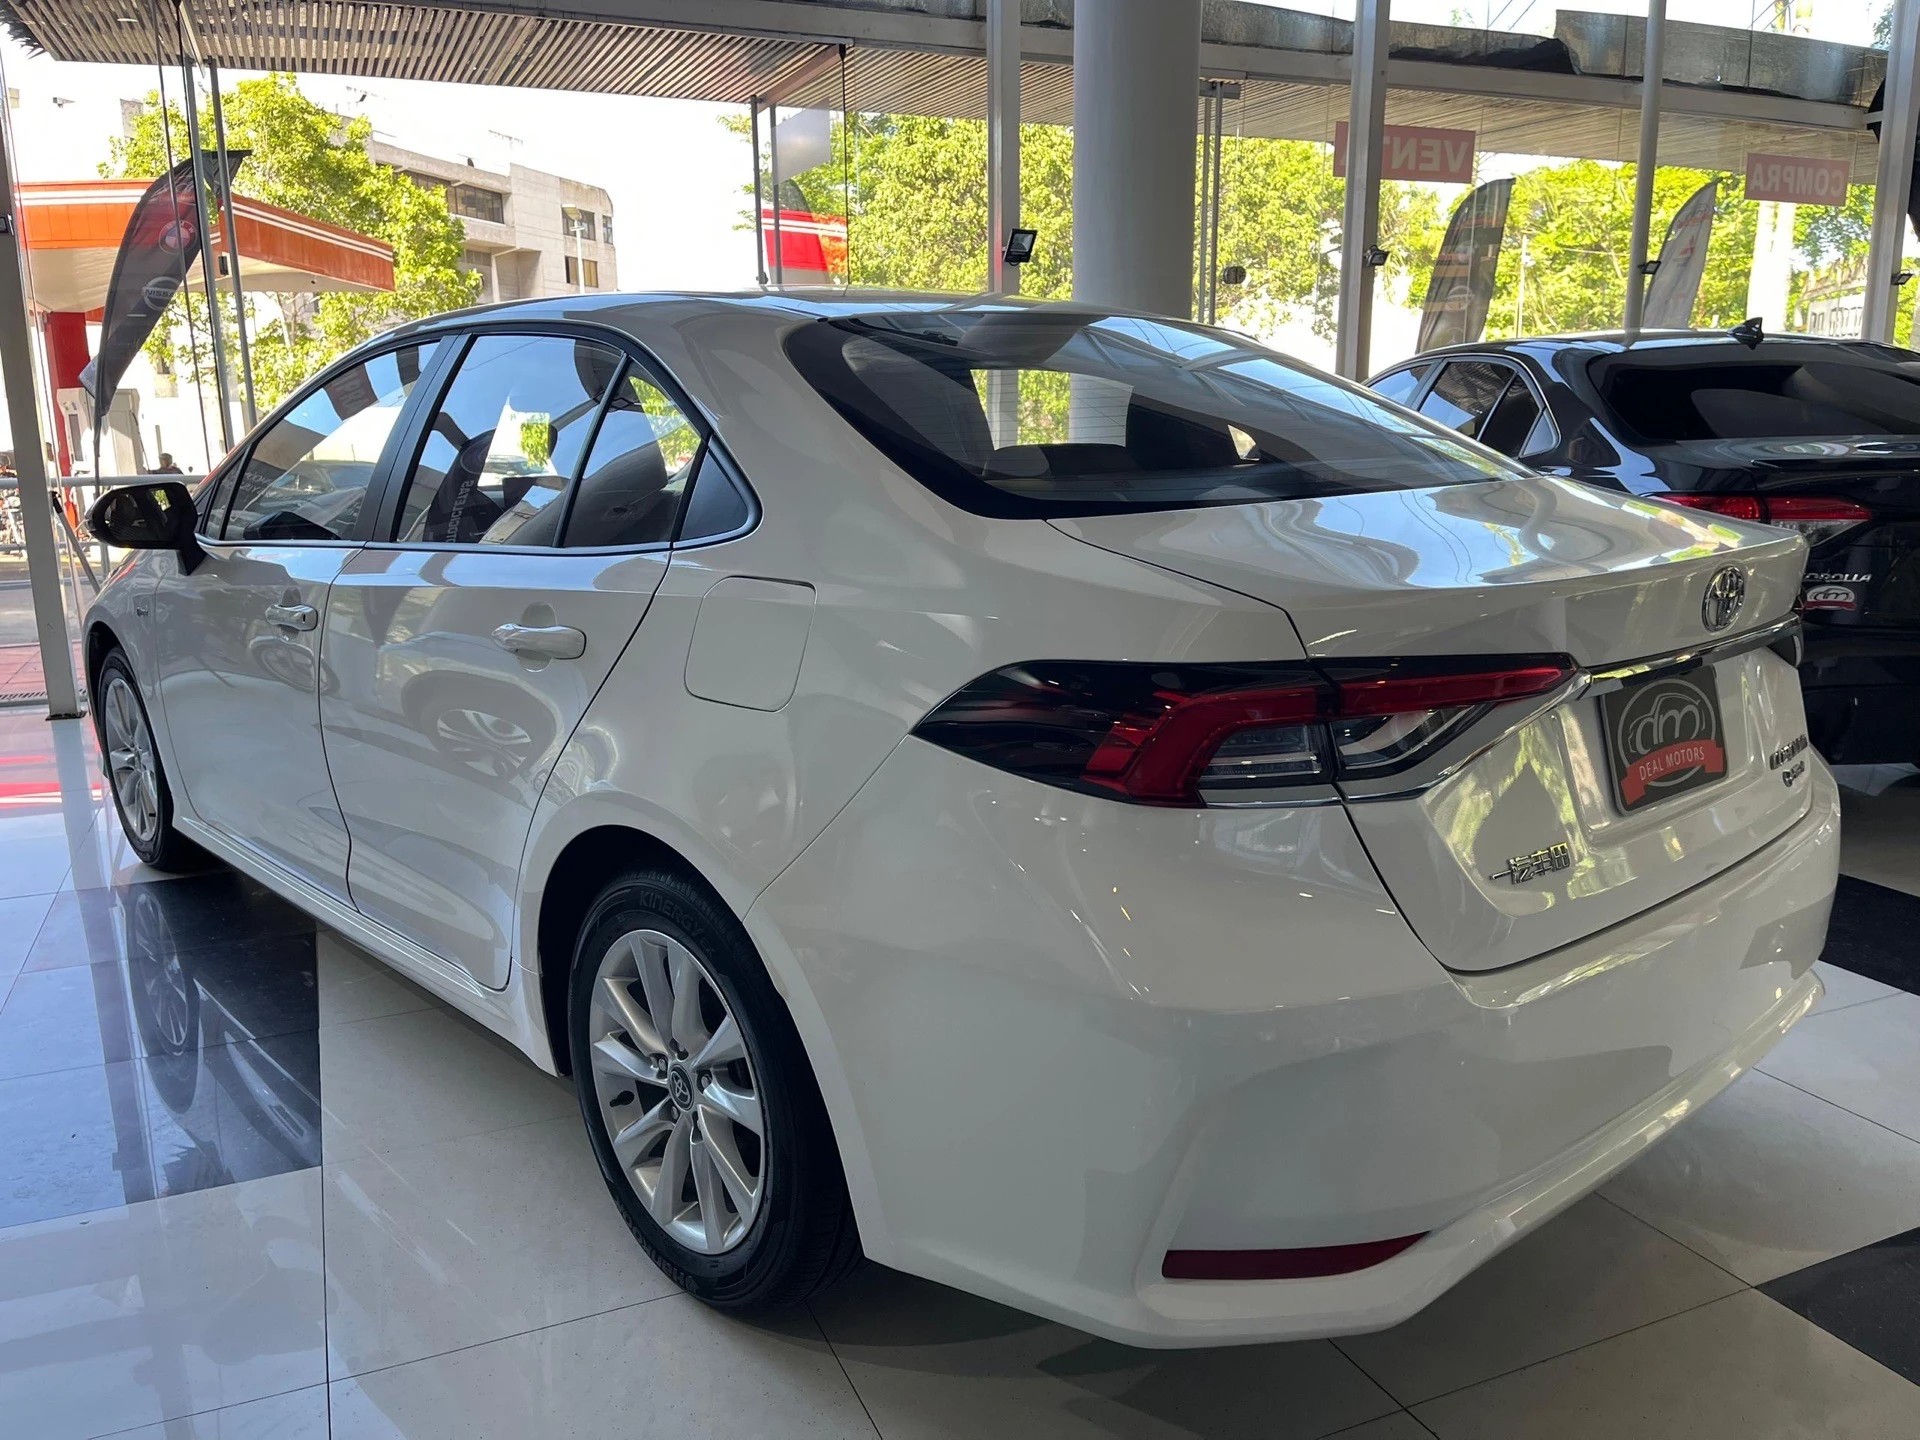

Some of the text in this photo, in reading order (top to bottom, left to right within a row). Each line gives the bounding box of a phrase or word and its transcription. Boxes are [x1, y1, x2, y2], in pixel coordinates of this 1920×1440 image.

[145, 289, 174, 298] NISSA
[1803, 572, 1872, 583] OROLLA
[1639, 746, 1705, 781] DEAL MOTORS
